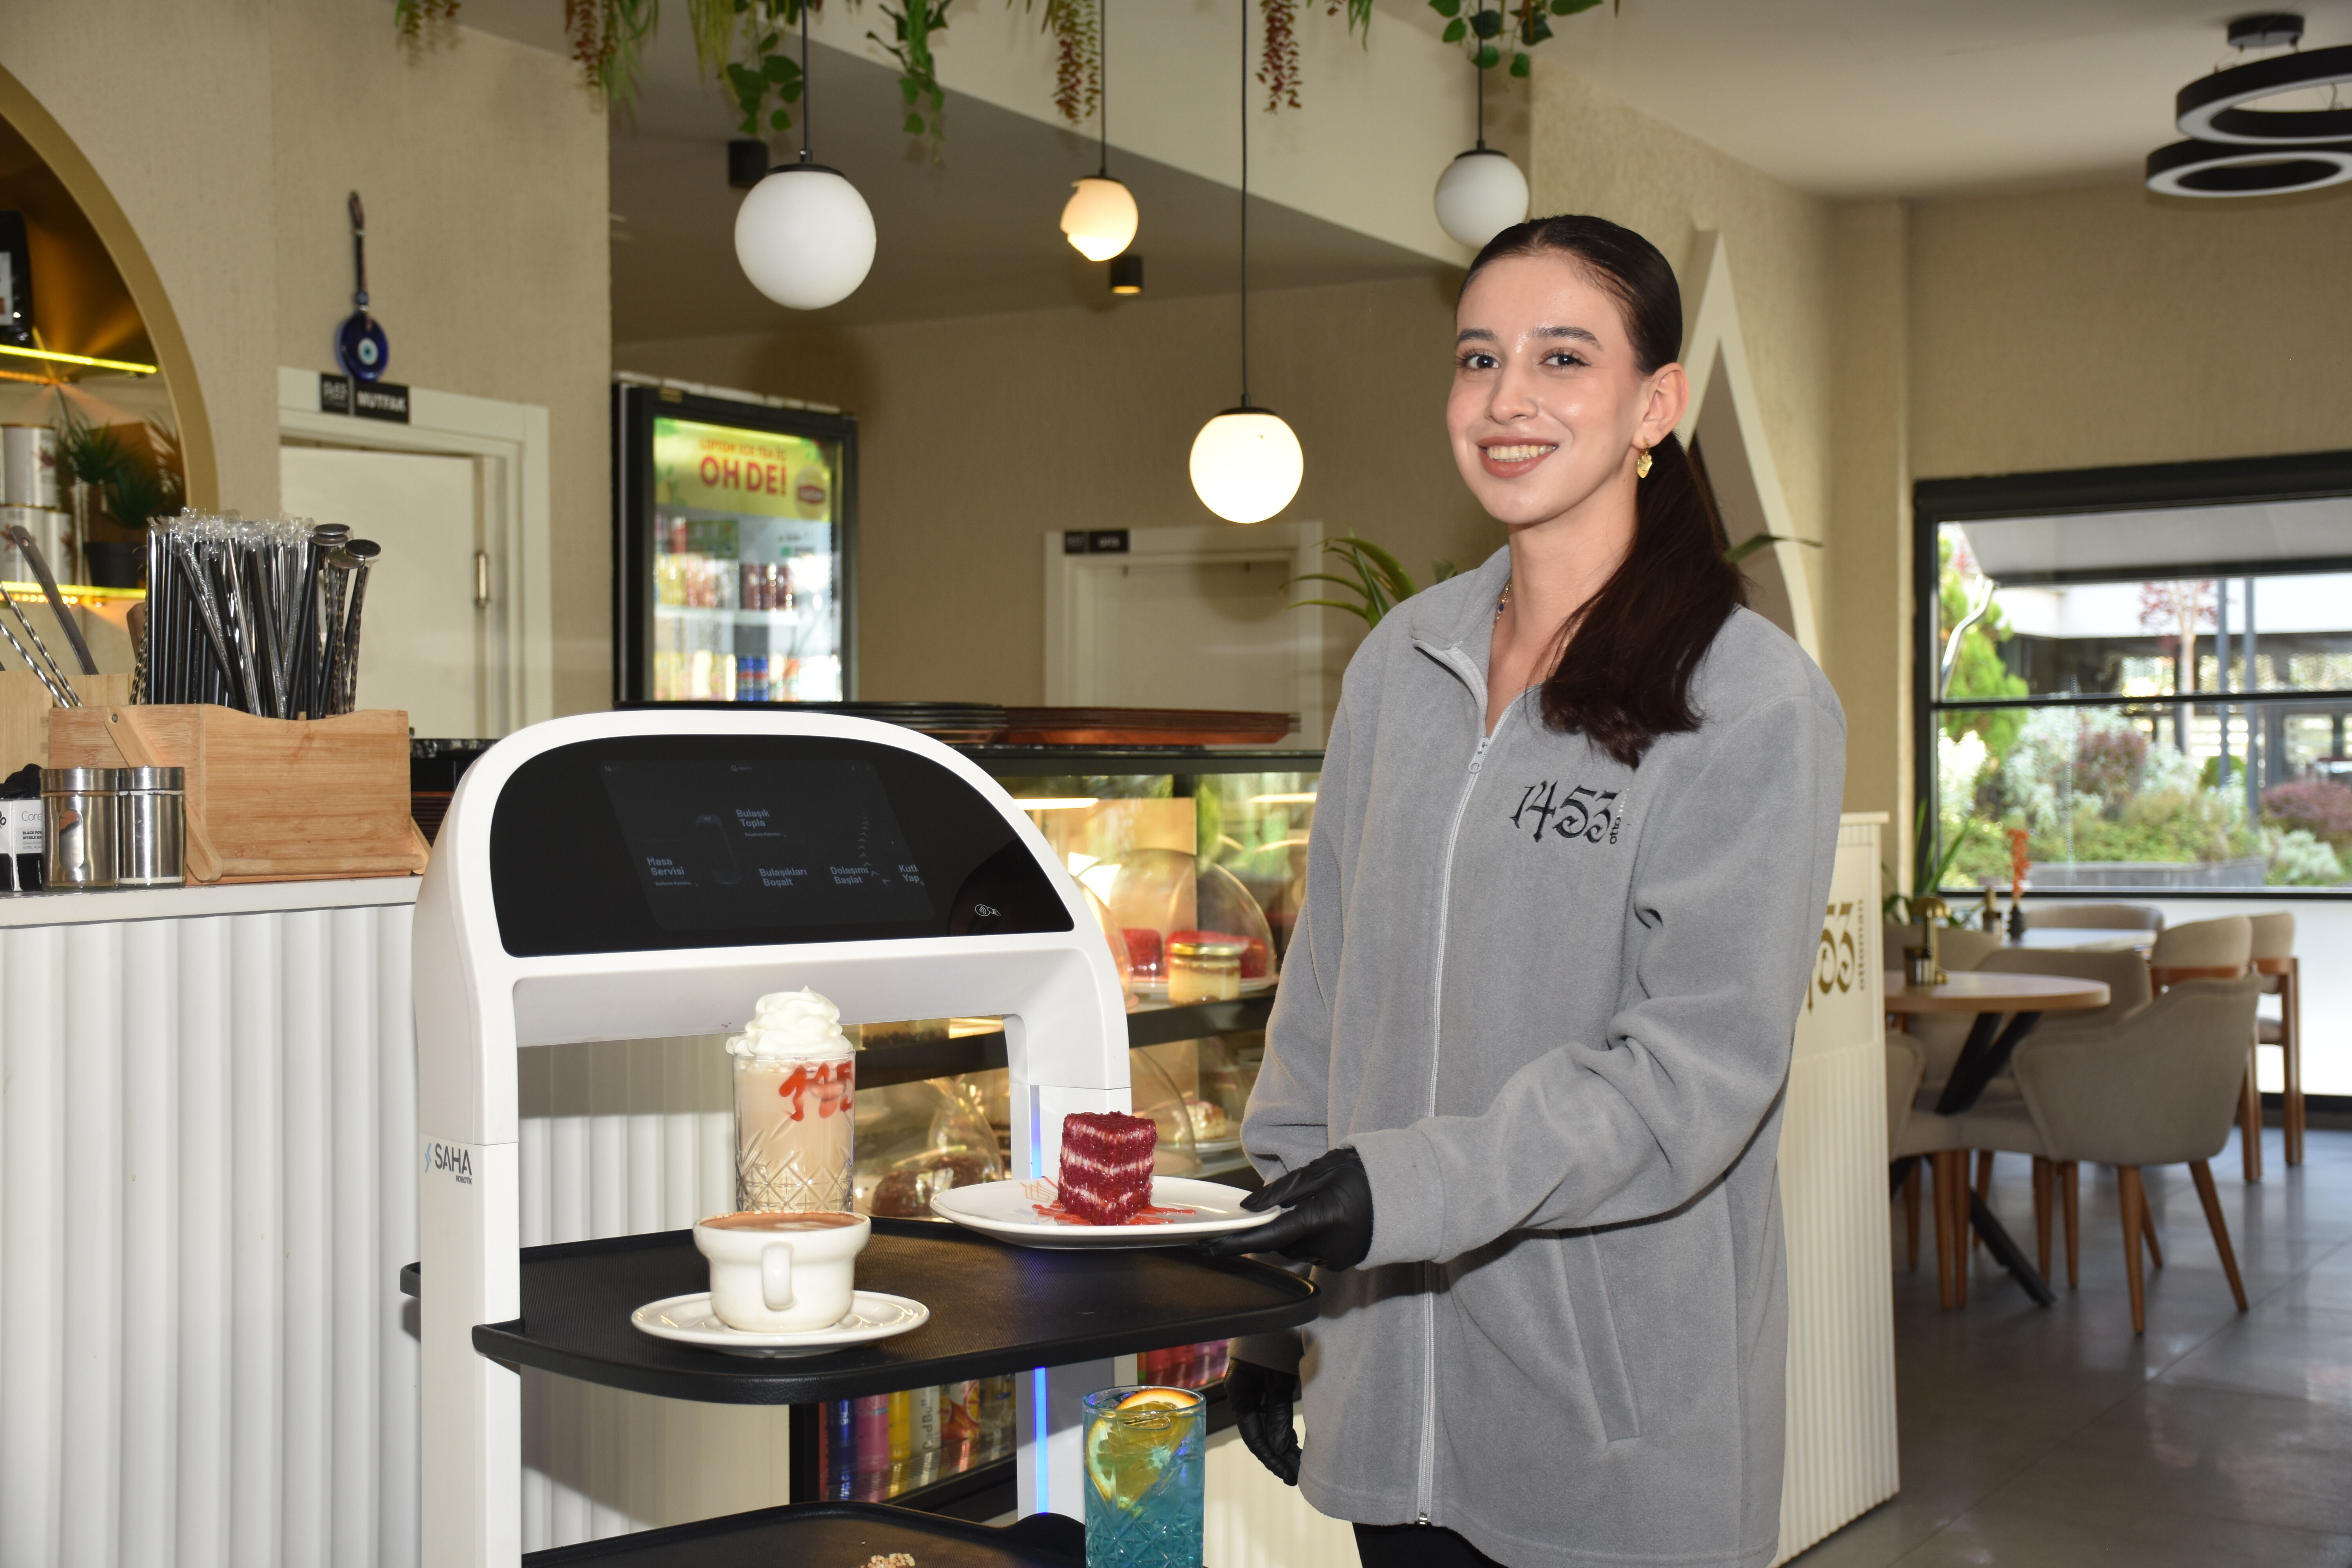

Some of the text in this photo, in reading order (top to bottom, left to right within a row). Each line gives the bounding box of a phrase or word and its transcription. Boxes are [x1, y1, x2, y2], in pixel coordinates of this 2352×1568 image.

[735, 809, 771, 818] Bulaşık
[1510, 780, 1622, 844] 1453
[739, 819, 766, 828] Topla
[646, 857, 673, 866] Masa
[650, 866, 685, 876] Servisi
[759, 867, 808, 877] Bulaşıkları
[830, 866, 869, 875] Dolaşımı
[762, 878, 793, 888] Boşalt
[833, 876, 864, 886] Başlat
[902, 874, 920, 883] Yap
[435, 1143, 472, 1176] SAHA
